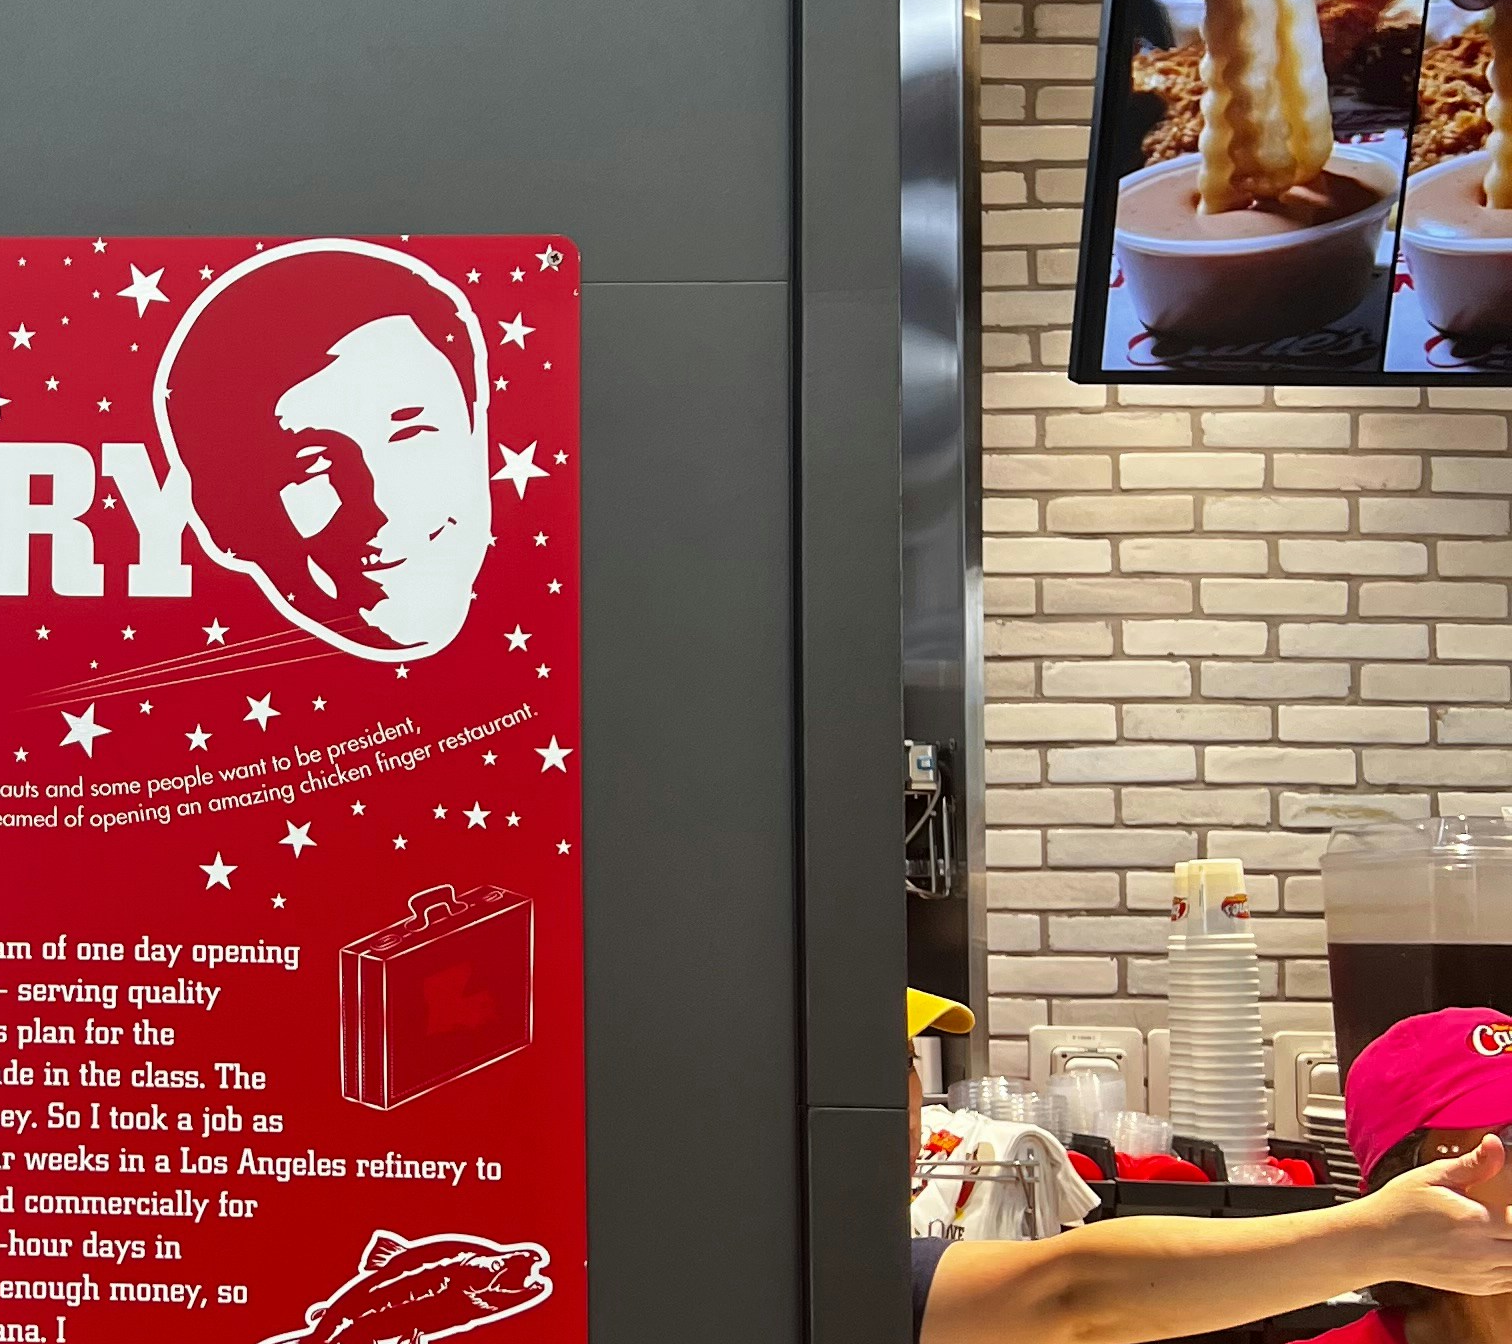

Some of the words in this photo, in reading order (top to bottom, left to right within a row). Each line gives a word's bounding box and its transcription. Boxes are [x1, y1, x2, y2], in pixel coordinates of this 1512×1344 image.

[45, 775, 84, 799] and
[90, 780, 141, 797] some
[147, 764, 214, 799] people
[218, 758, 267, 782] want
[271, 755, 292, 773] to
[294, 745, 323, 767] be
[326, 716, 421, 765] president,
[63, 804, 85, 828] of
[89, 802, 171, 833] opening
[176, 801, 202, 817] an
[208, 783, 295, 812] amazing
[299, 763, 373, 794] chicken
[374, 744, 432, 773] finger
[437, 702, 538, 753] restaurant.
[42, 933, 68, 961] of
[76, 942, 125, 961] one
[134, 935, 184, 969] day
[192, 939, 301, 971] opening
[1472, 1024, 1512, 1057] Ca
[23, 1144, 110, 1172] weeks
[118, 1147, 146, 1173] in
[154, 1154, 172, 1174] a
[179, 1146, 228, 1175] Los
[236, 1147, 347, 1183] Angeles
[355, 1151, 468, 1187] refinery
[475, 1156, 502, 1181] to
[82, 1230, 146, 1265] days
[154, 1233, 183, 1260] in
[0, 1273, 101, 1307] enough
[109, 1282, 208, 1310] money,
[217, 1285, 248, 1304] so
